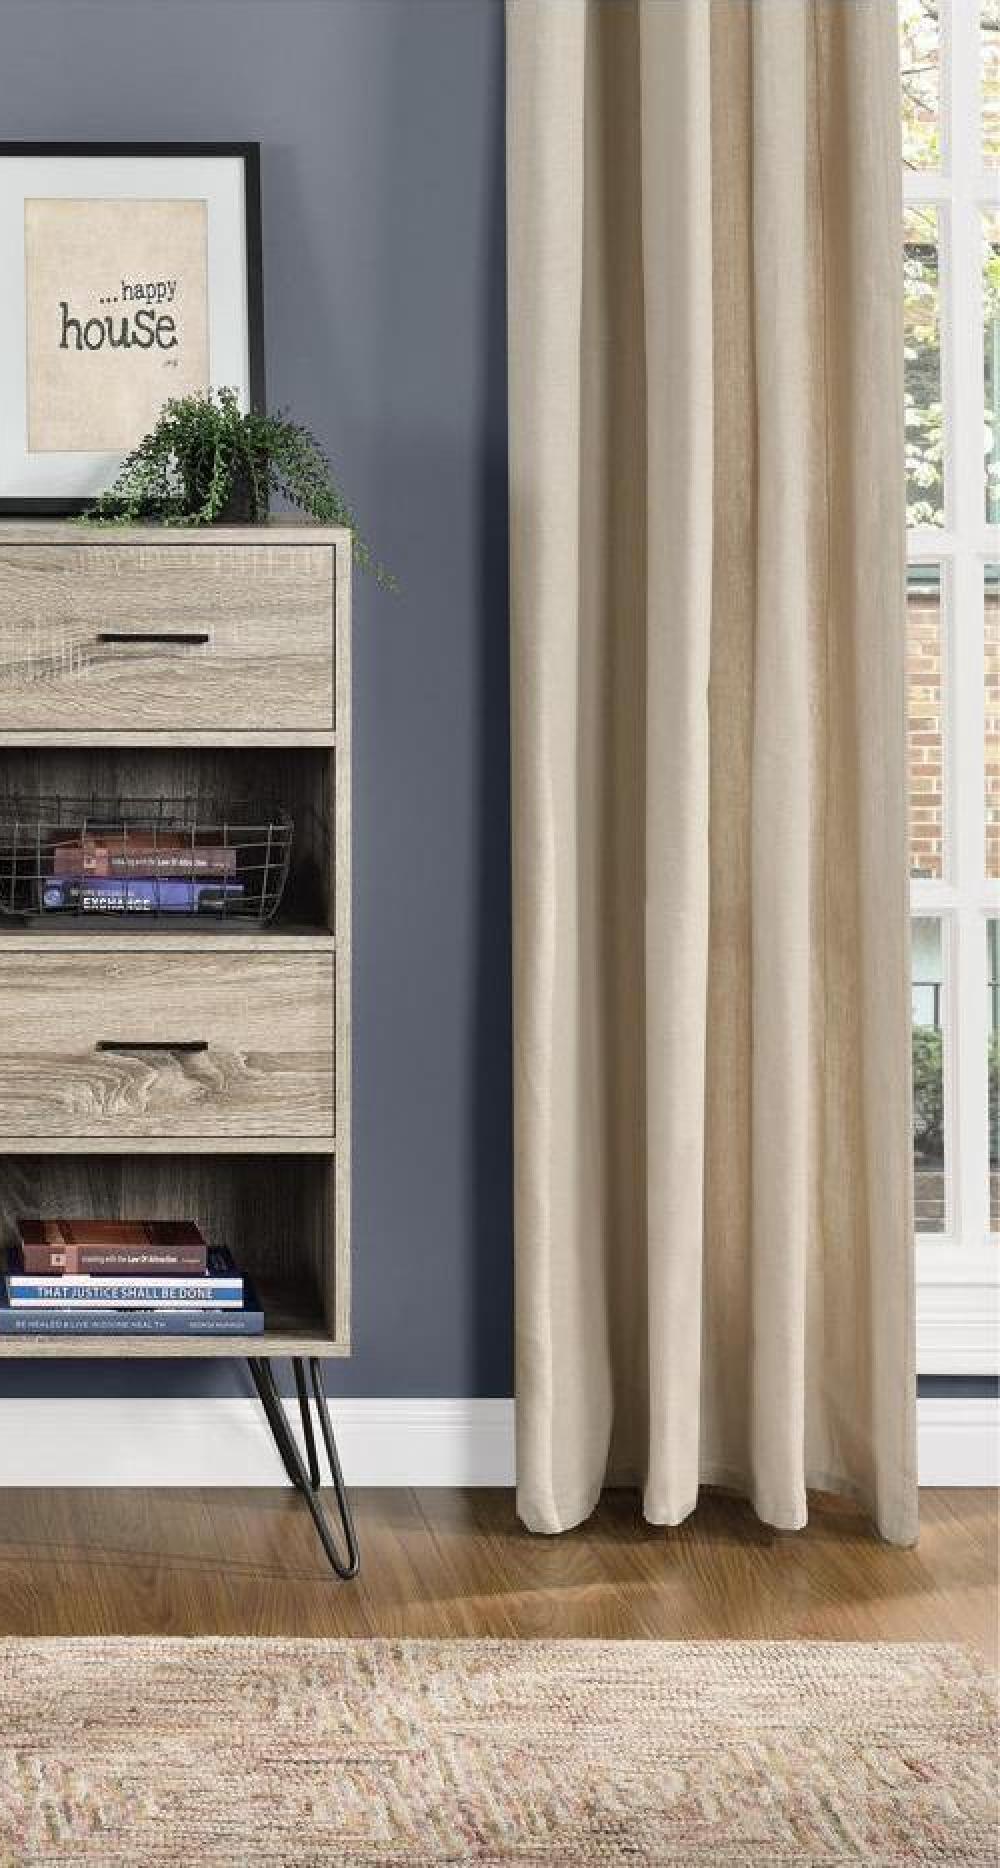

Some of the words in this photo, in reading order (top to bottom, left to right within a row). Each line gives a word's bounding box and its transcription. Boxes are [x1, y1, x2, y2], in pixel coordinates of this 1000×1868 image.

[59, 301, 179, 351] house
[38, 1286, 69, 1298] THAT
[71, 1286, 118, 1299] JUSTICE
[121, 1286, 159, 1299] SHALL
[161, 1286, 177, 1299] BE
[180, 1286, 216, 1299] DONE
